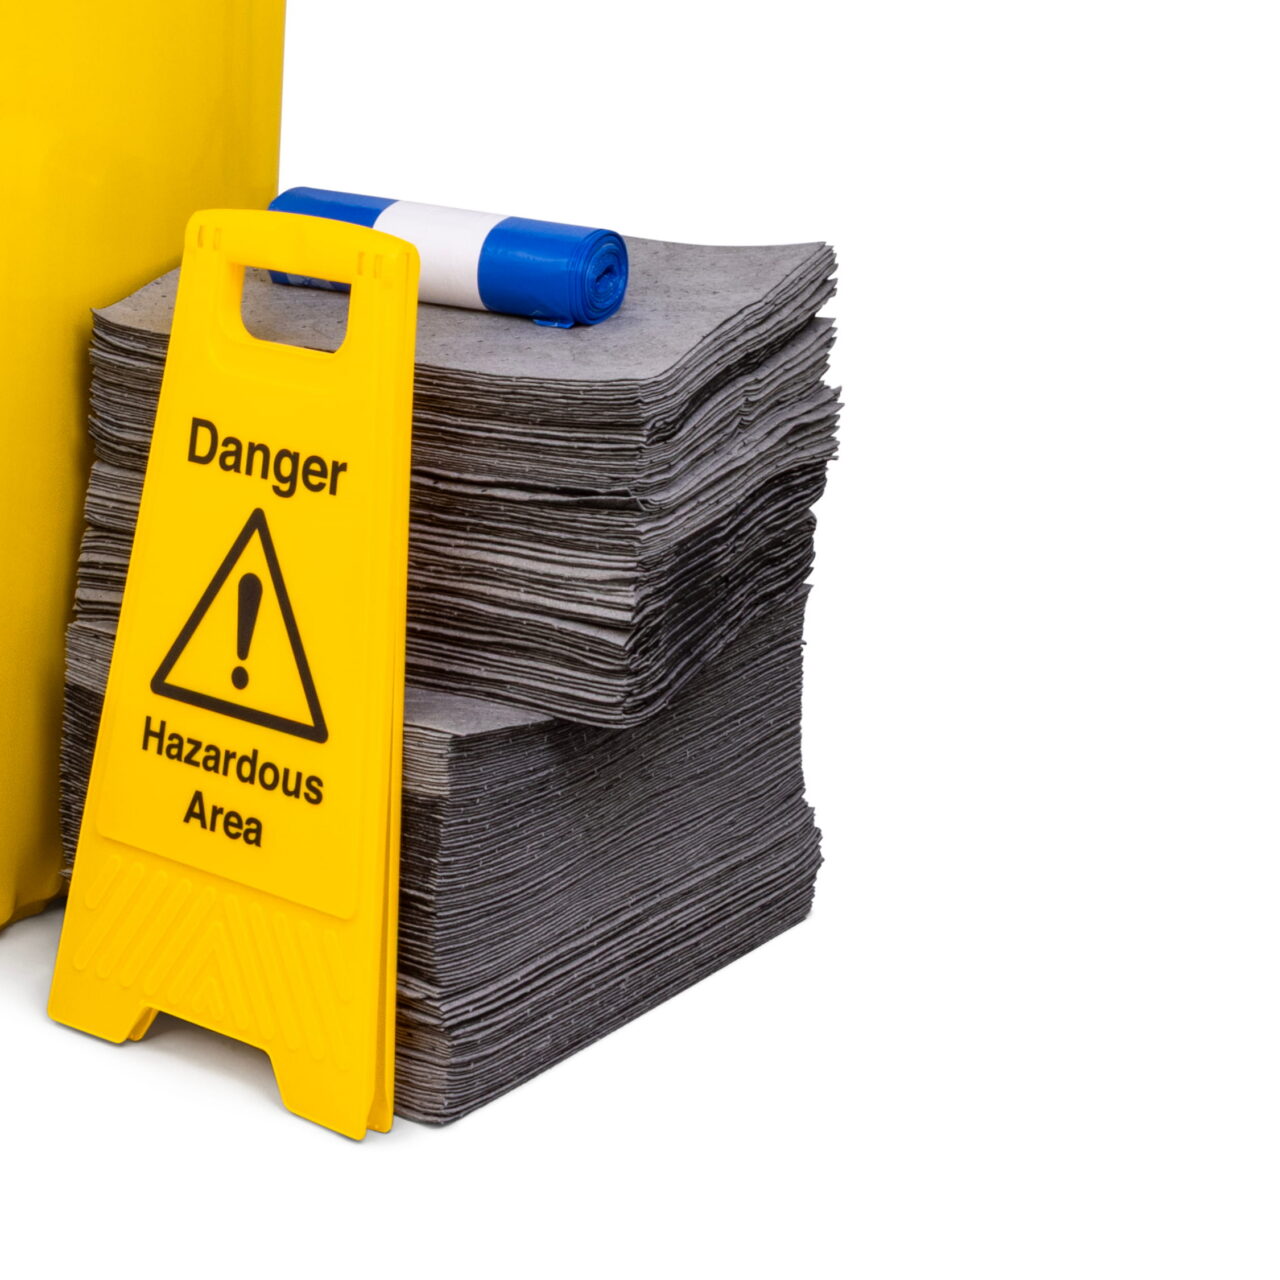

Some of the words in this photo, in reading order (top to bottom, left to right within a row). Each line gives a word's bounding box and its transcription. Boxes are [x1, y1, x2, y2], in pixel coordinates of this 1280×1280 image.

[187, 416, 348, 498] Danger
[141, 715, 324, 805] Hazardous
[183, 790, 263, 848] Area
